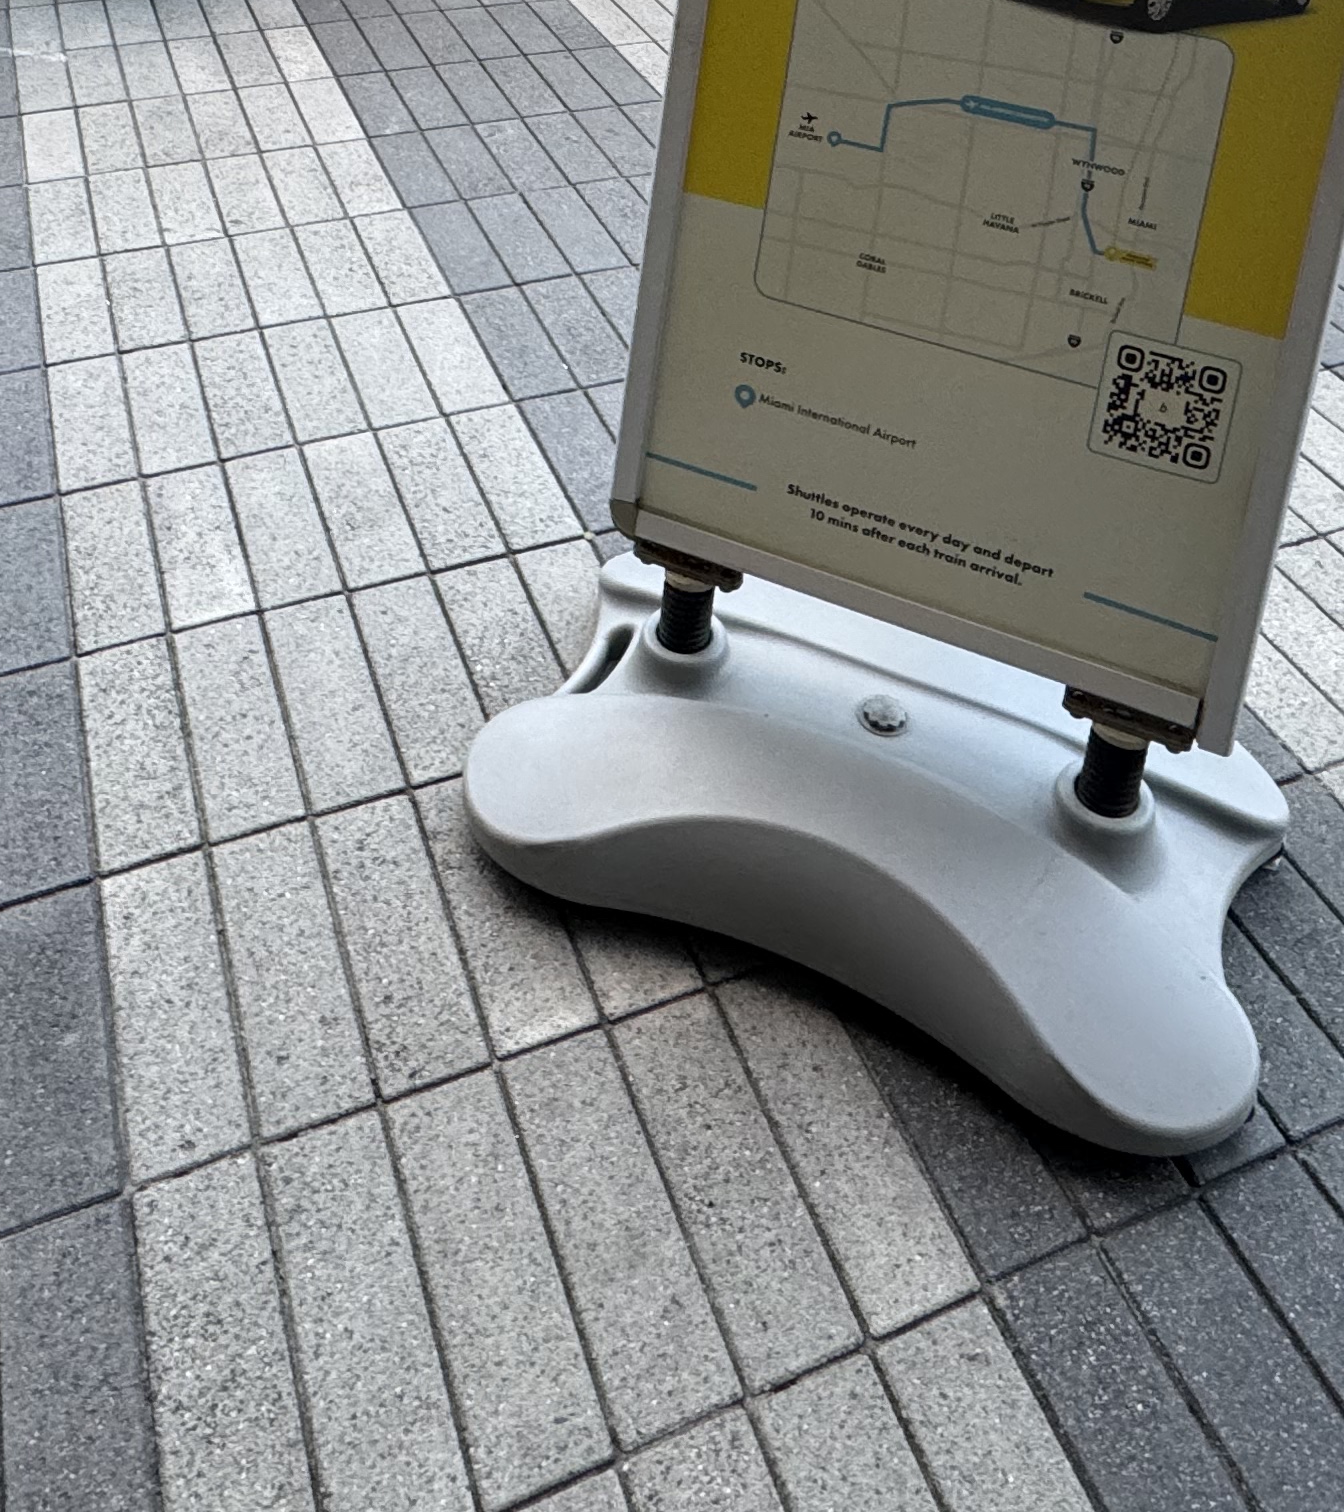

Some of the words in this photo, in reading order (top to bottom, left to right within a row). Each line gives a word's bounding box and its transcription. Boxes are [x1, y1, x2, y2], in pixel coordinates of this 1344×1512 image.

[788, 130, 823, 143] AIRPORT
[982, 218, 1020, 234] HAVANA
[990, 212, 1016, 225] LITTLE
[1128, 217, 1158, 230] MIAMI
[1069, 288, 1108, 305] BRICKELL
[758, 392, 795, 413] Miami
[796, 404, 871, 435] International
[872, 427, 917, 449] Airport
[786, 483, 840, 509] Shuttles
[841, 503, 896, 527] operate
[898, 522, 940, 543] every
[942, 533, 971, 553] day
[972, 545, 1002, 561] and
[1004, 553, 1055, 578] depart
[809, 507, 826, 522] 10
[827, 515, 860, 533] mins
[861, 526, 896, 545] after
[897, 538, 931, 556] each
[933, 548, 967, 568] train
[969, 561, 1023, 586] arrival.
